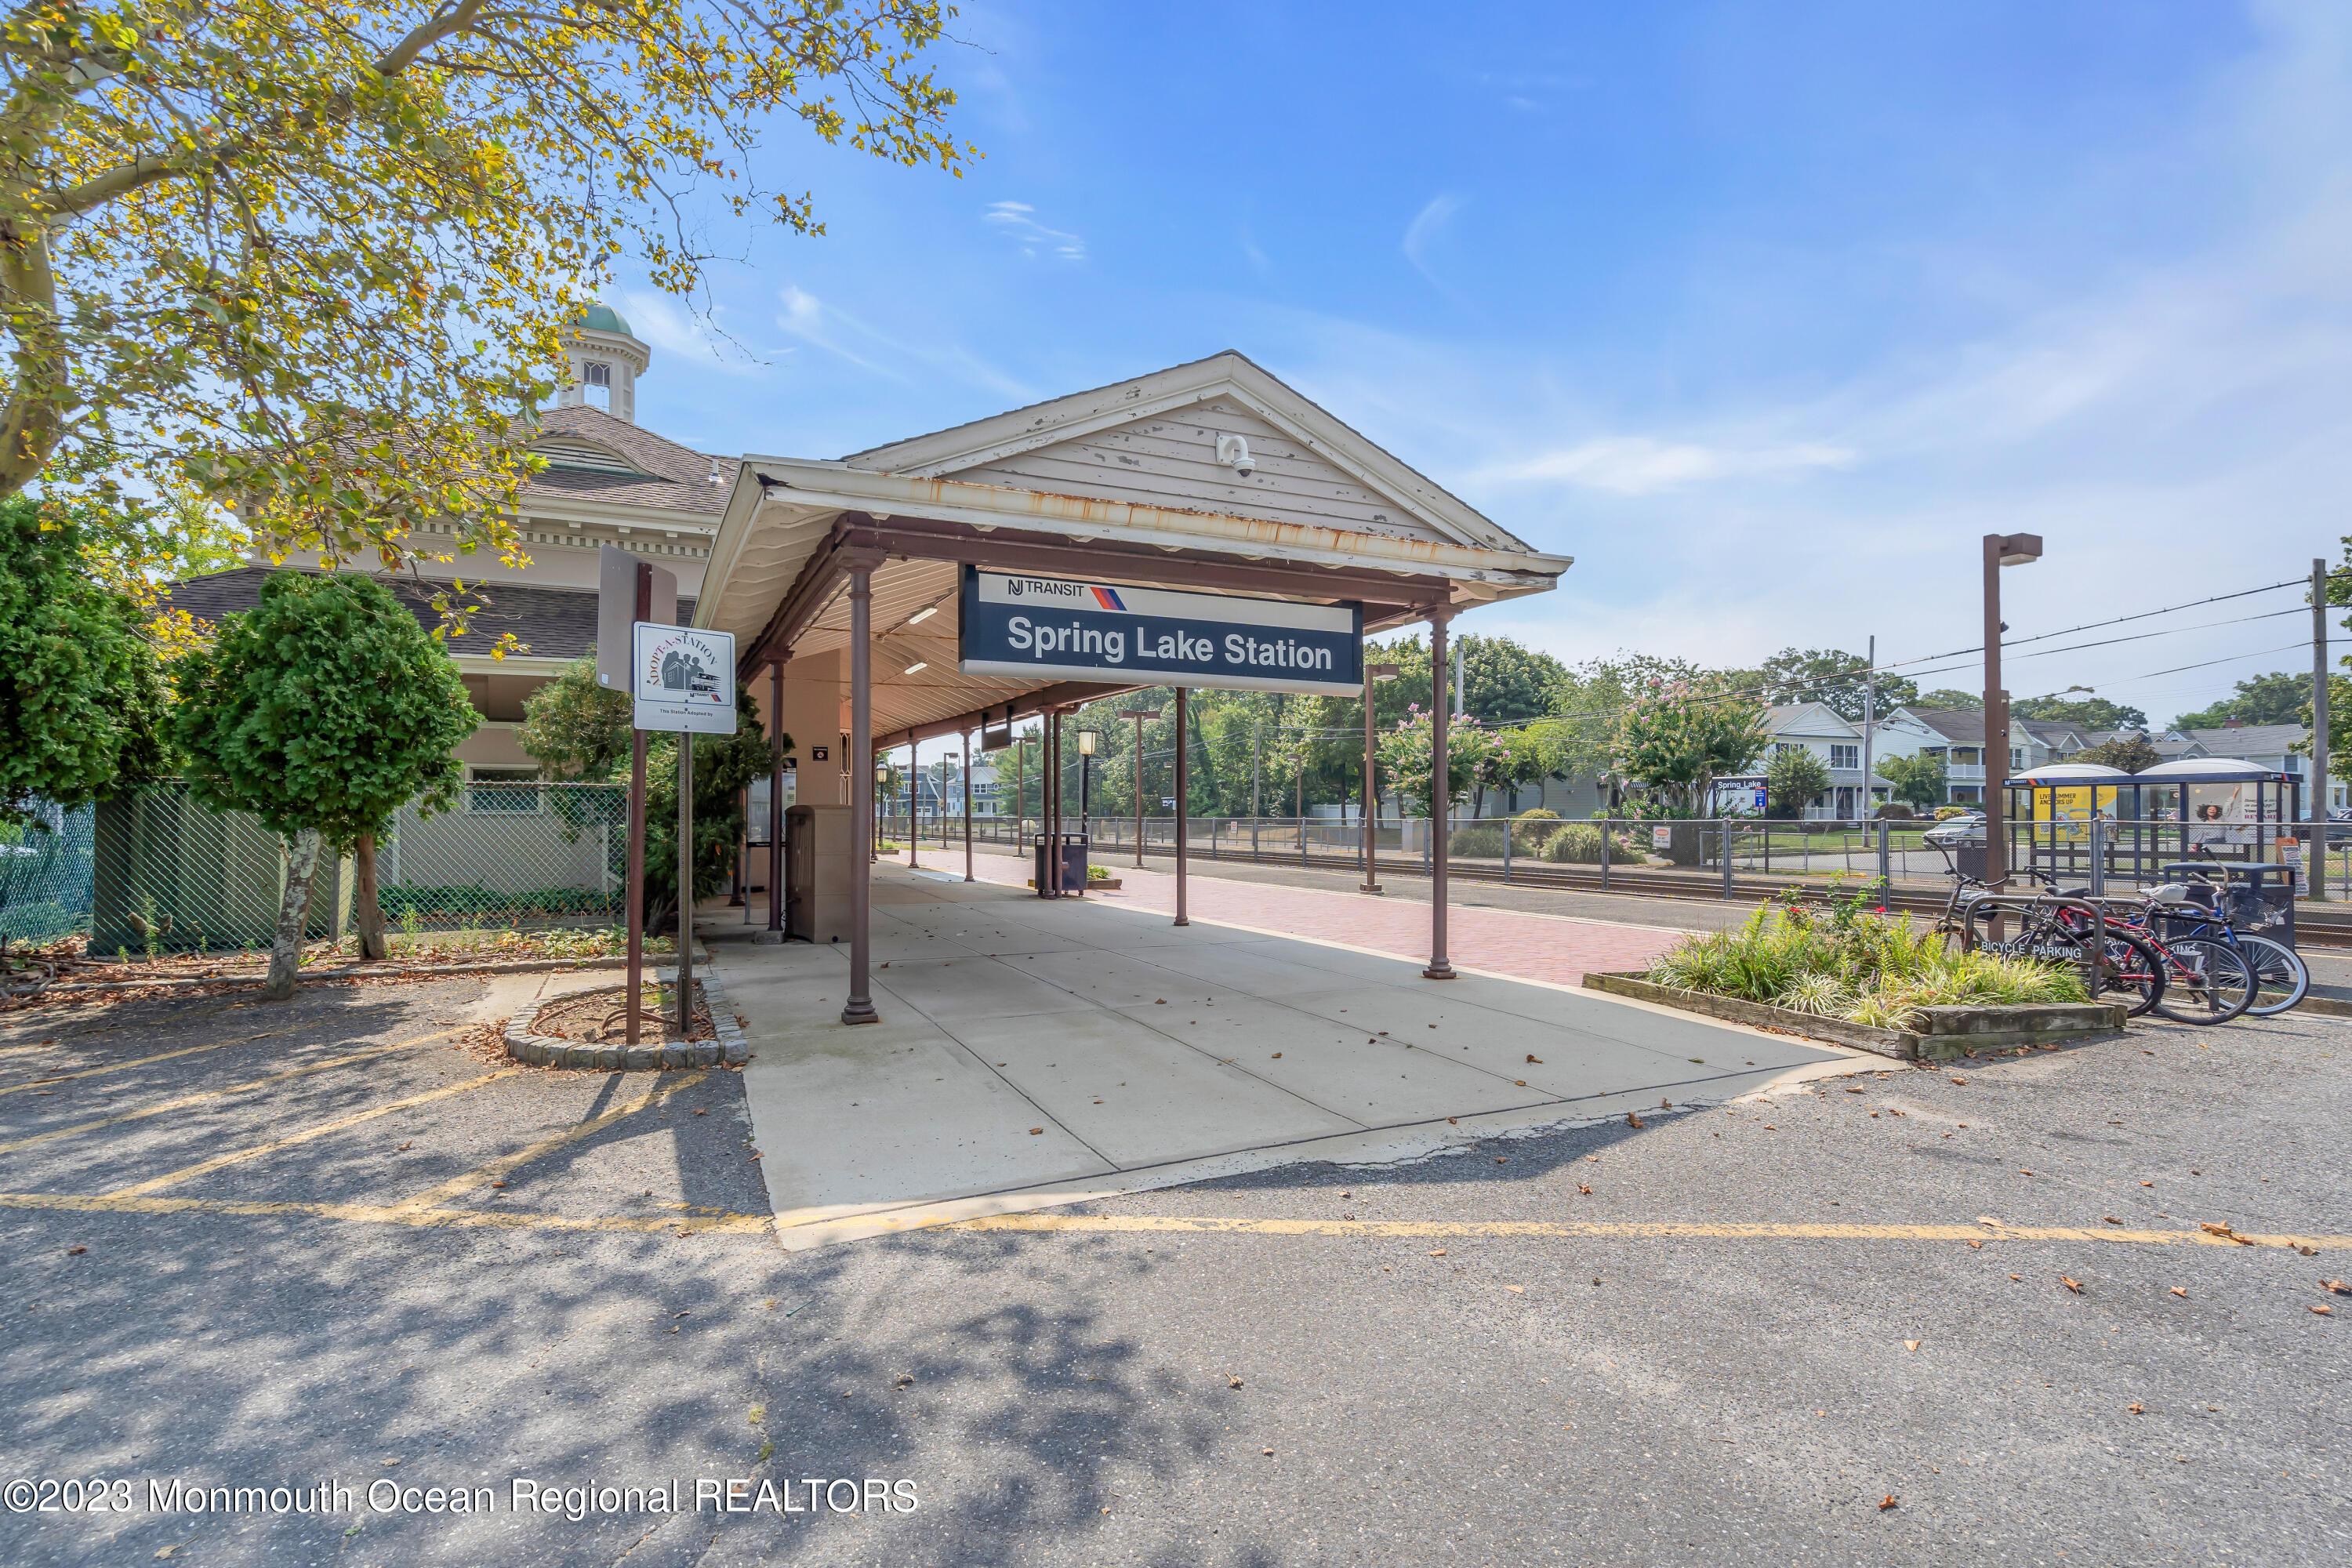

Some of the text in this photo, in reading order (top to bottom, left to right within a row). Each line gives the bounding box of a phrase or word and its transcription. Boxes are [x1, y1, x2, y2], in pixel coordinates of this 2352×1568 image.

[1008, 579, 1084, 597] NJ TRANSIT
[1007, 616, 1332, 670] Spring Lake Station
[649, 635, 718, 687] ADOPT-A-STATION
[1718, 781, 1740, 790] Spring
[1981, 941, 2082, 959] BICYCLE PARKING
